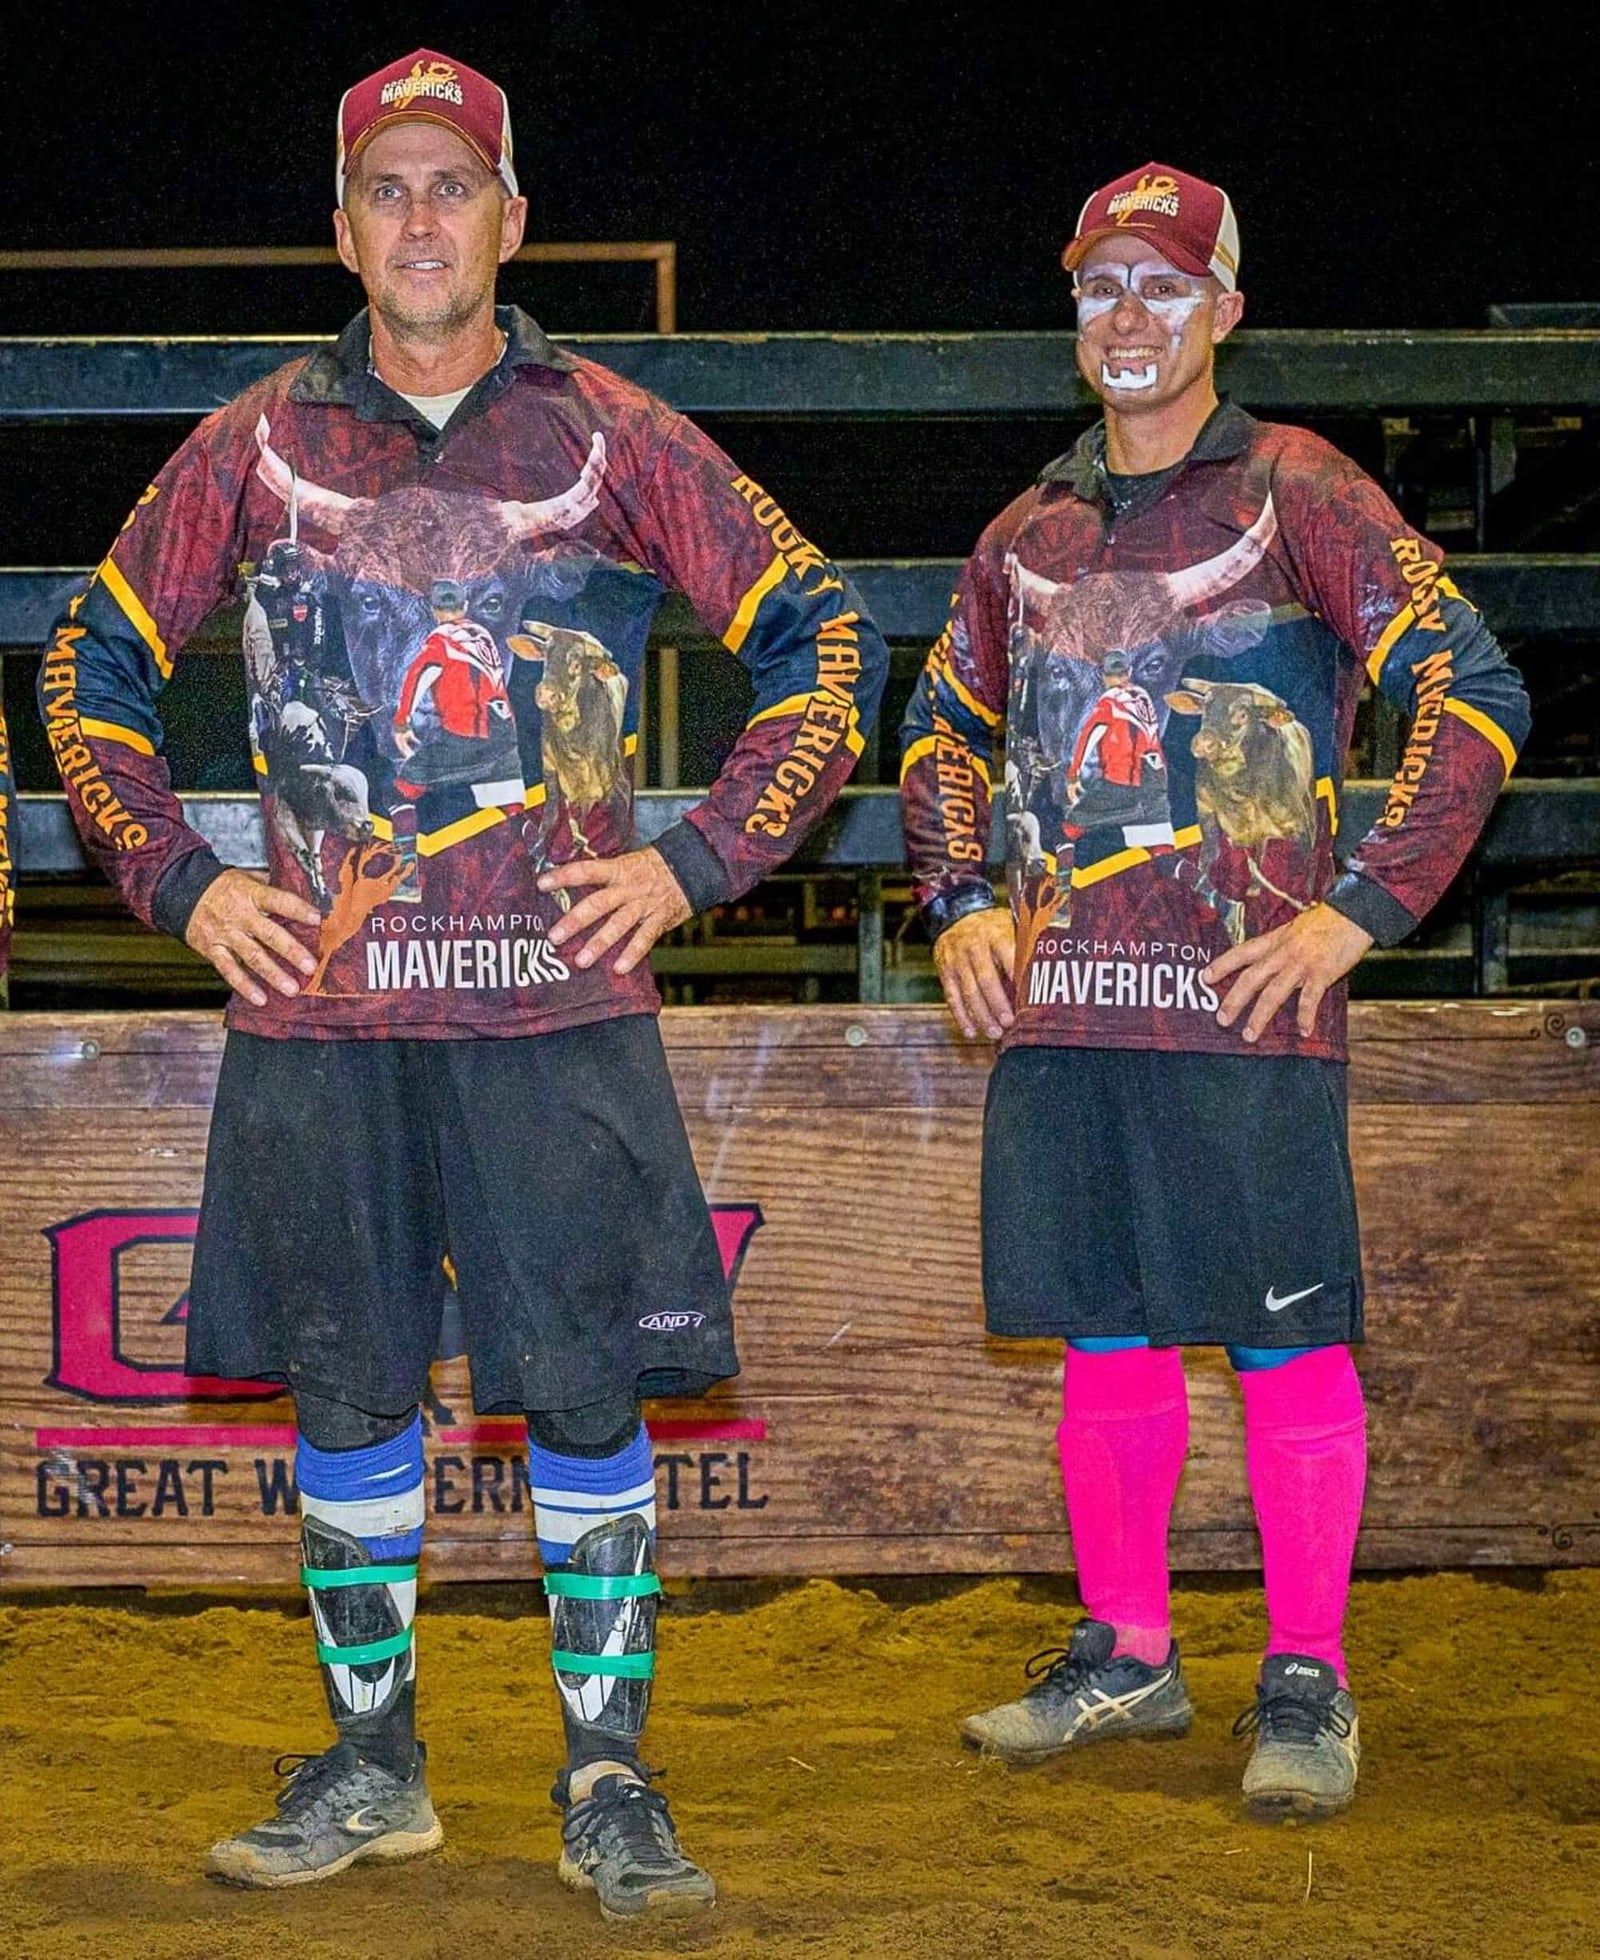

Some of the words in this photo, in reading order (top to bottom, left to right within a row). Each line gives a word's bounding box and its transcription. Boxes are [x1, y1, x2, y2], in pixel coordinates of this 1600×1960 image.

[380, 81, 463, 105] MAVERICKS
[1106, 195, 1180, 217] MAVERICKS
[371, 914, 545, 934] ROCKHAMPTO
[1035, 939, 1212, 963] ROCKHAMPTON
[366, 938, 571, 990] MAVERICKS
[1028, 960, 1220, 1012] MAVERICKS
[36, 1457, 229, 1518] GREAT
